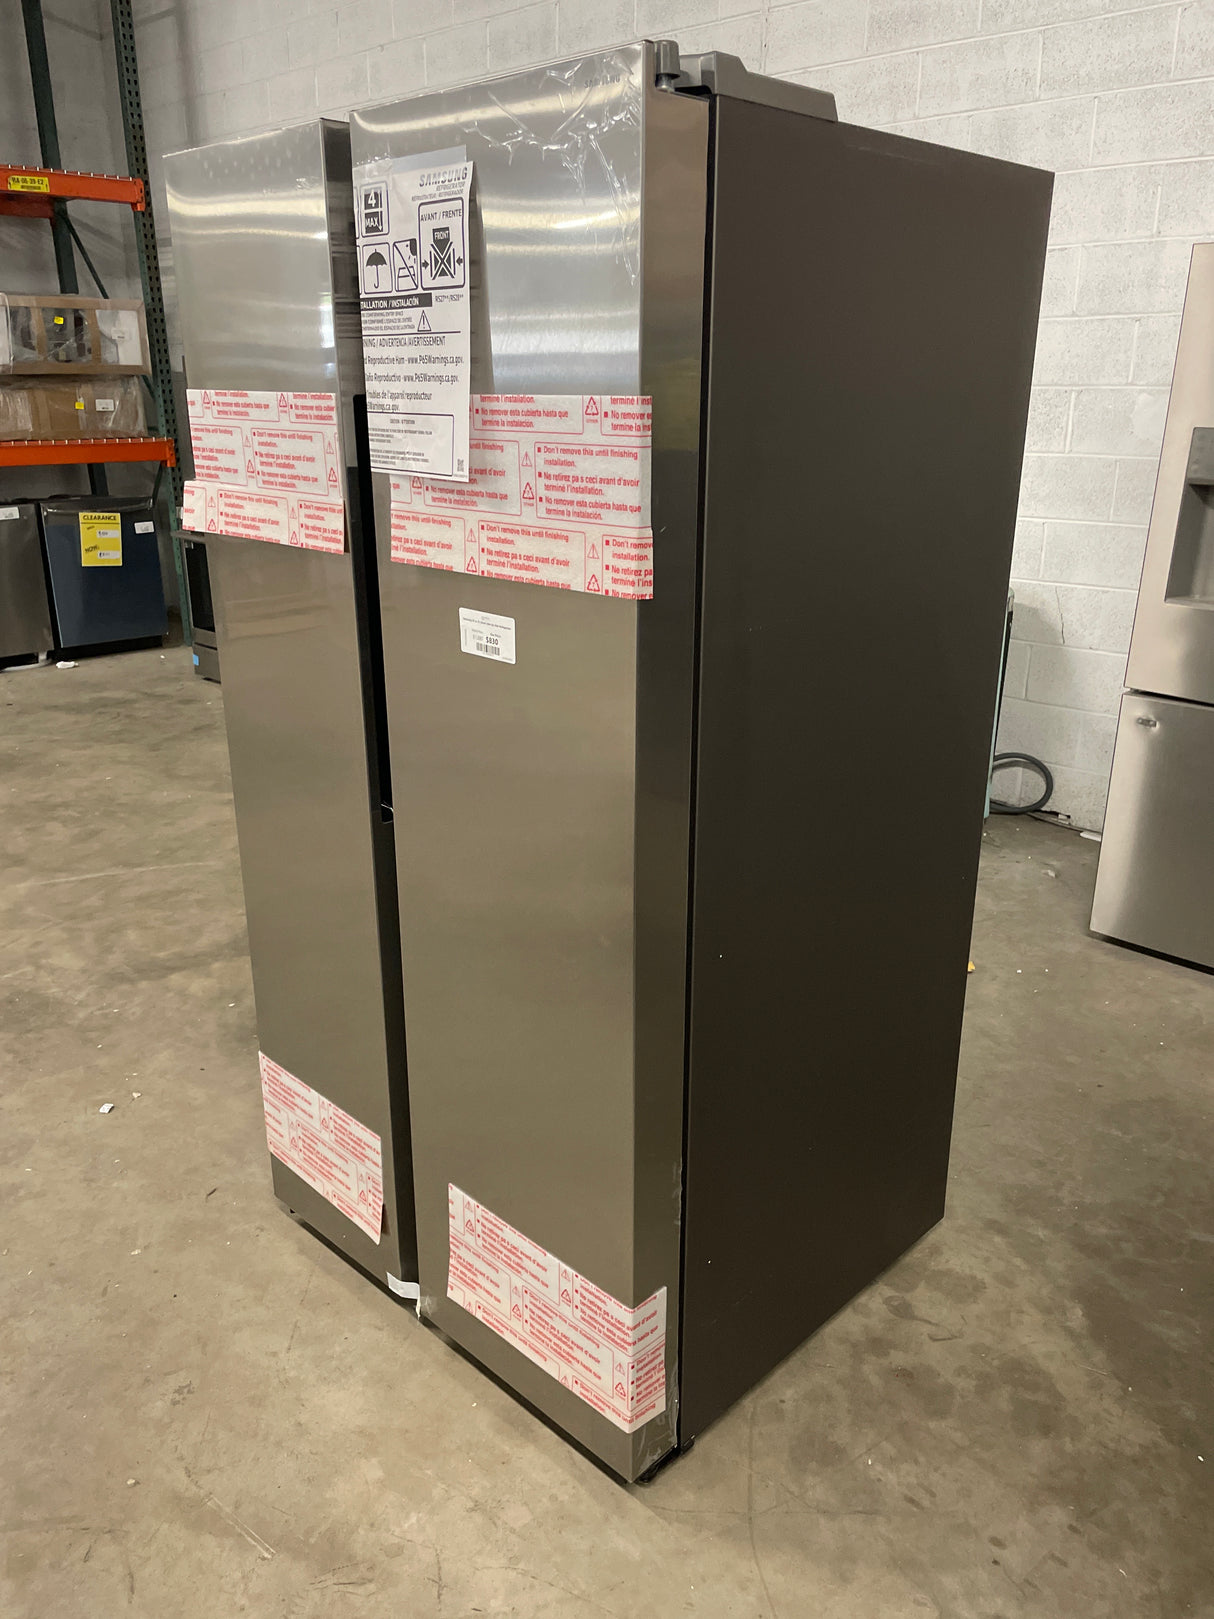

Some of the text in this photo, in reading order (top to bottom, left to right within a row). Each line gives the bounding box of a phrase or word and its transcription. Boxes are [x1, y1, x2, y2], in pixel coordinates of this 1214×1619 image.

[420, 167, 467, 187] SAMSUNG
[368, 189, 376, 207] 4
[421, 212, 437, 221] AVANT
[442, 209, 462, 218] FRENTE
[366, 218, 378, 227] MAX
[435, 231, 448, 240] FRONT
[368, 355, 395, 366] Reproductive
[558, 411, 568, 419] que
[612, 410, 619, 419] No
[635, 423, 641, 432] la
[611, 449, 638, 460] finishing
[586, 475, 597, 483] ceci
[545, 496, 552, 504] No
[589, 501, 611, 509] cubierta
[612, 502, 627, 511] hasta
[629, 505, 641, 513] que
[545, 531, 569, 542] finishing
[612, 539, 628, 548] Don't
[523, 554, 534, 562] ceci
[612, 565, 620, 574] Ne
[622, 567, 642, 576] retirez
